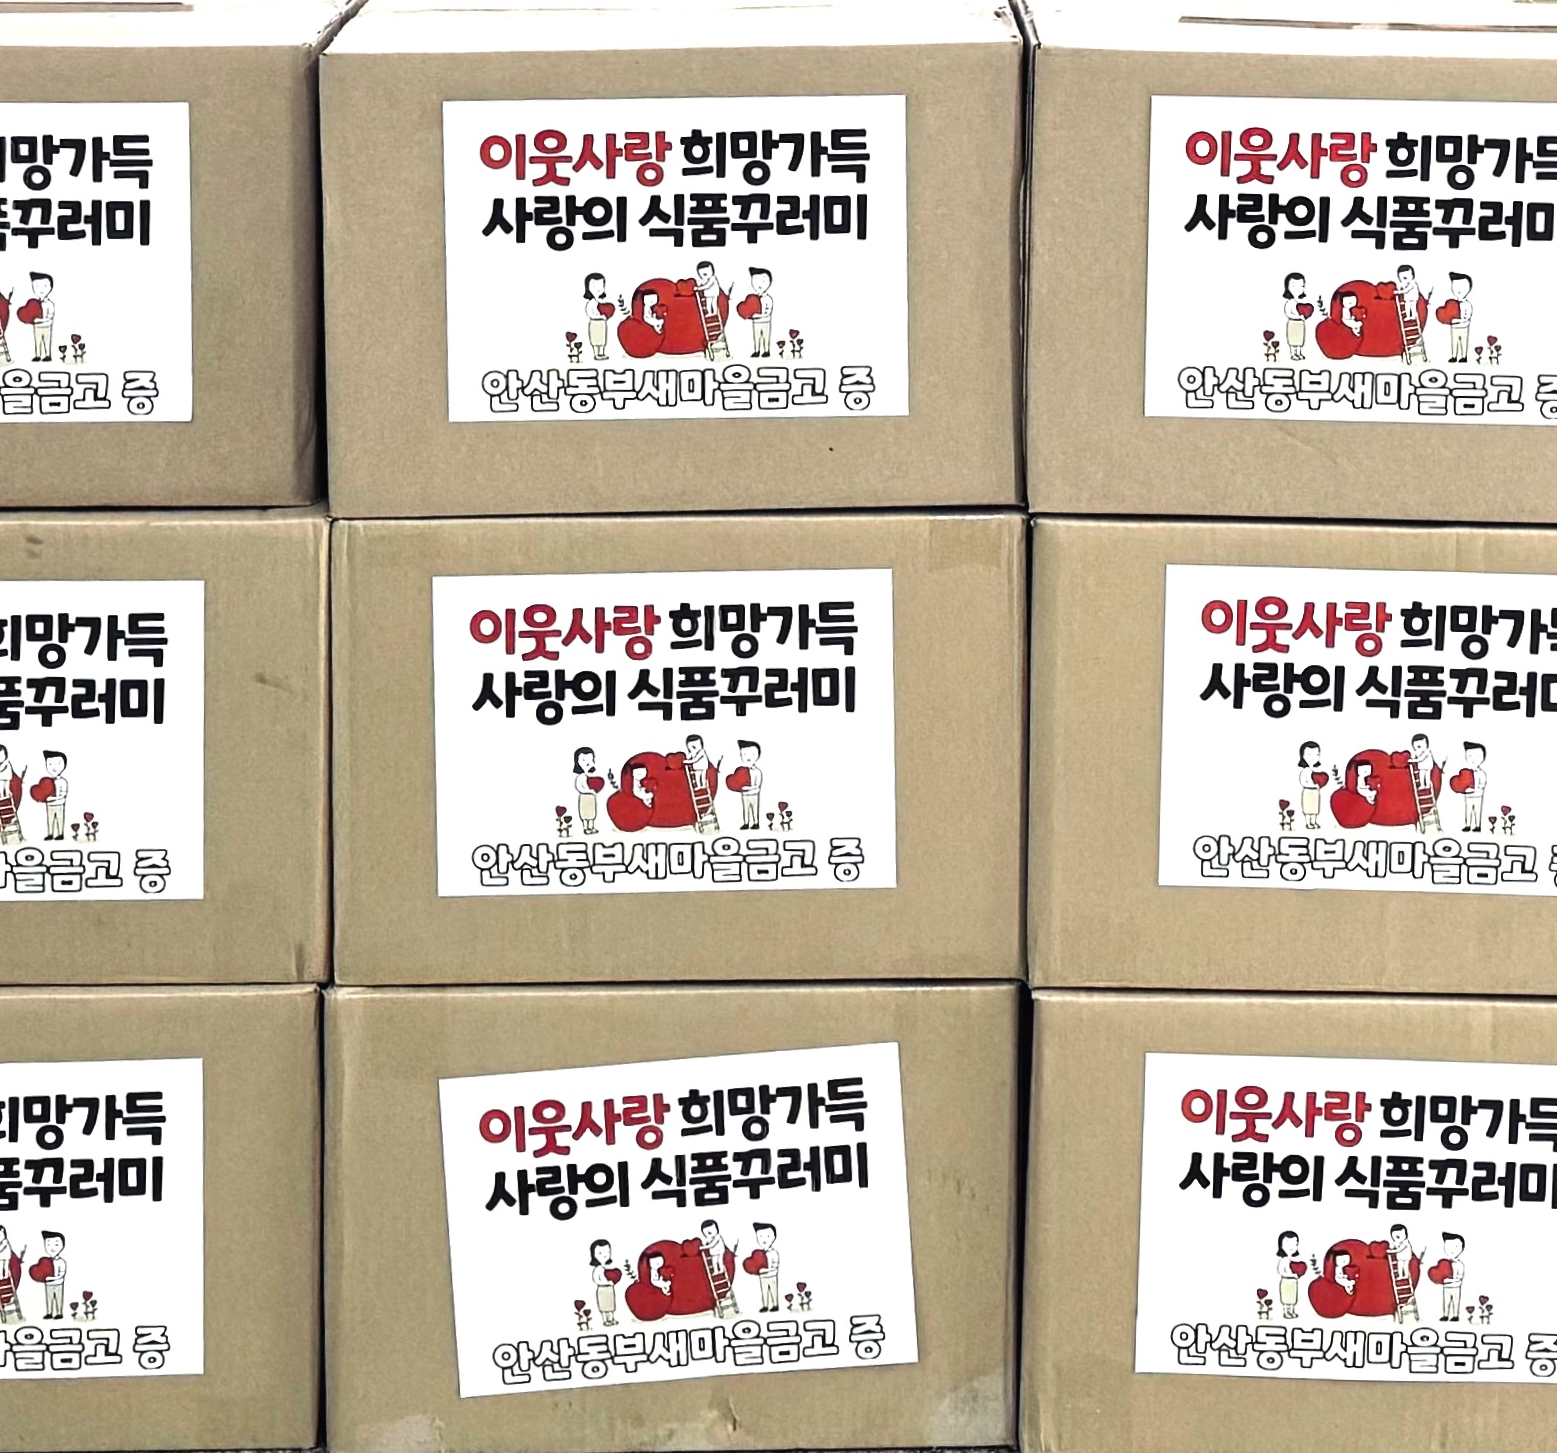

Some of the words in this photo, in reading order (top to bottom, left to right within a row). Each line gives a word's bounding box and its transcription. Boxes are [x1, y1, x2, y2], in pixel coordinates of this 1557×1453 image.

[478, 128, 673, 188] 이웃사랑
[679, 127, 872, 188] 희망가득
[480, 194, 629, 253] 사랑의
[637, 191, 869, 249] 식품꾸러미
[481, 363, 830, 415] 안산동부새마을금고
[838, 364, 877, 411] 증
[467, 603, 662, 663] 이웃사랑
[667, 600, 860, 661] 희망가득
[1199, 595, 1393, 659] 이웃사랑
[470, 668, 618, 727] 사랑의
[626, 664, 857, 722] 식품꾸러미
[1198, 660, 1347, 720] 사랑의
[132, 848, 172, 895] 증
[471, 836, 819, 889] 안산동부새마을금고
[827, 836, 866, 883] 증
[1192, 833, 1539, 887] 안산동부새마을금고
[477, 1092, 671, 1159] 이웃사랑
[676, 1076, 870, 1143] 희망가득
[484, 1160, 631, 1222] 사랑의
[639, 1140, 870, 1210] 식품꾸러미
[492, 1317, 841, 1387] 안산동부새마을금고
[848, 1311, 887, 1360] 증
